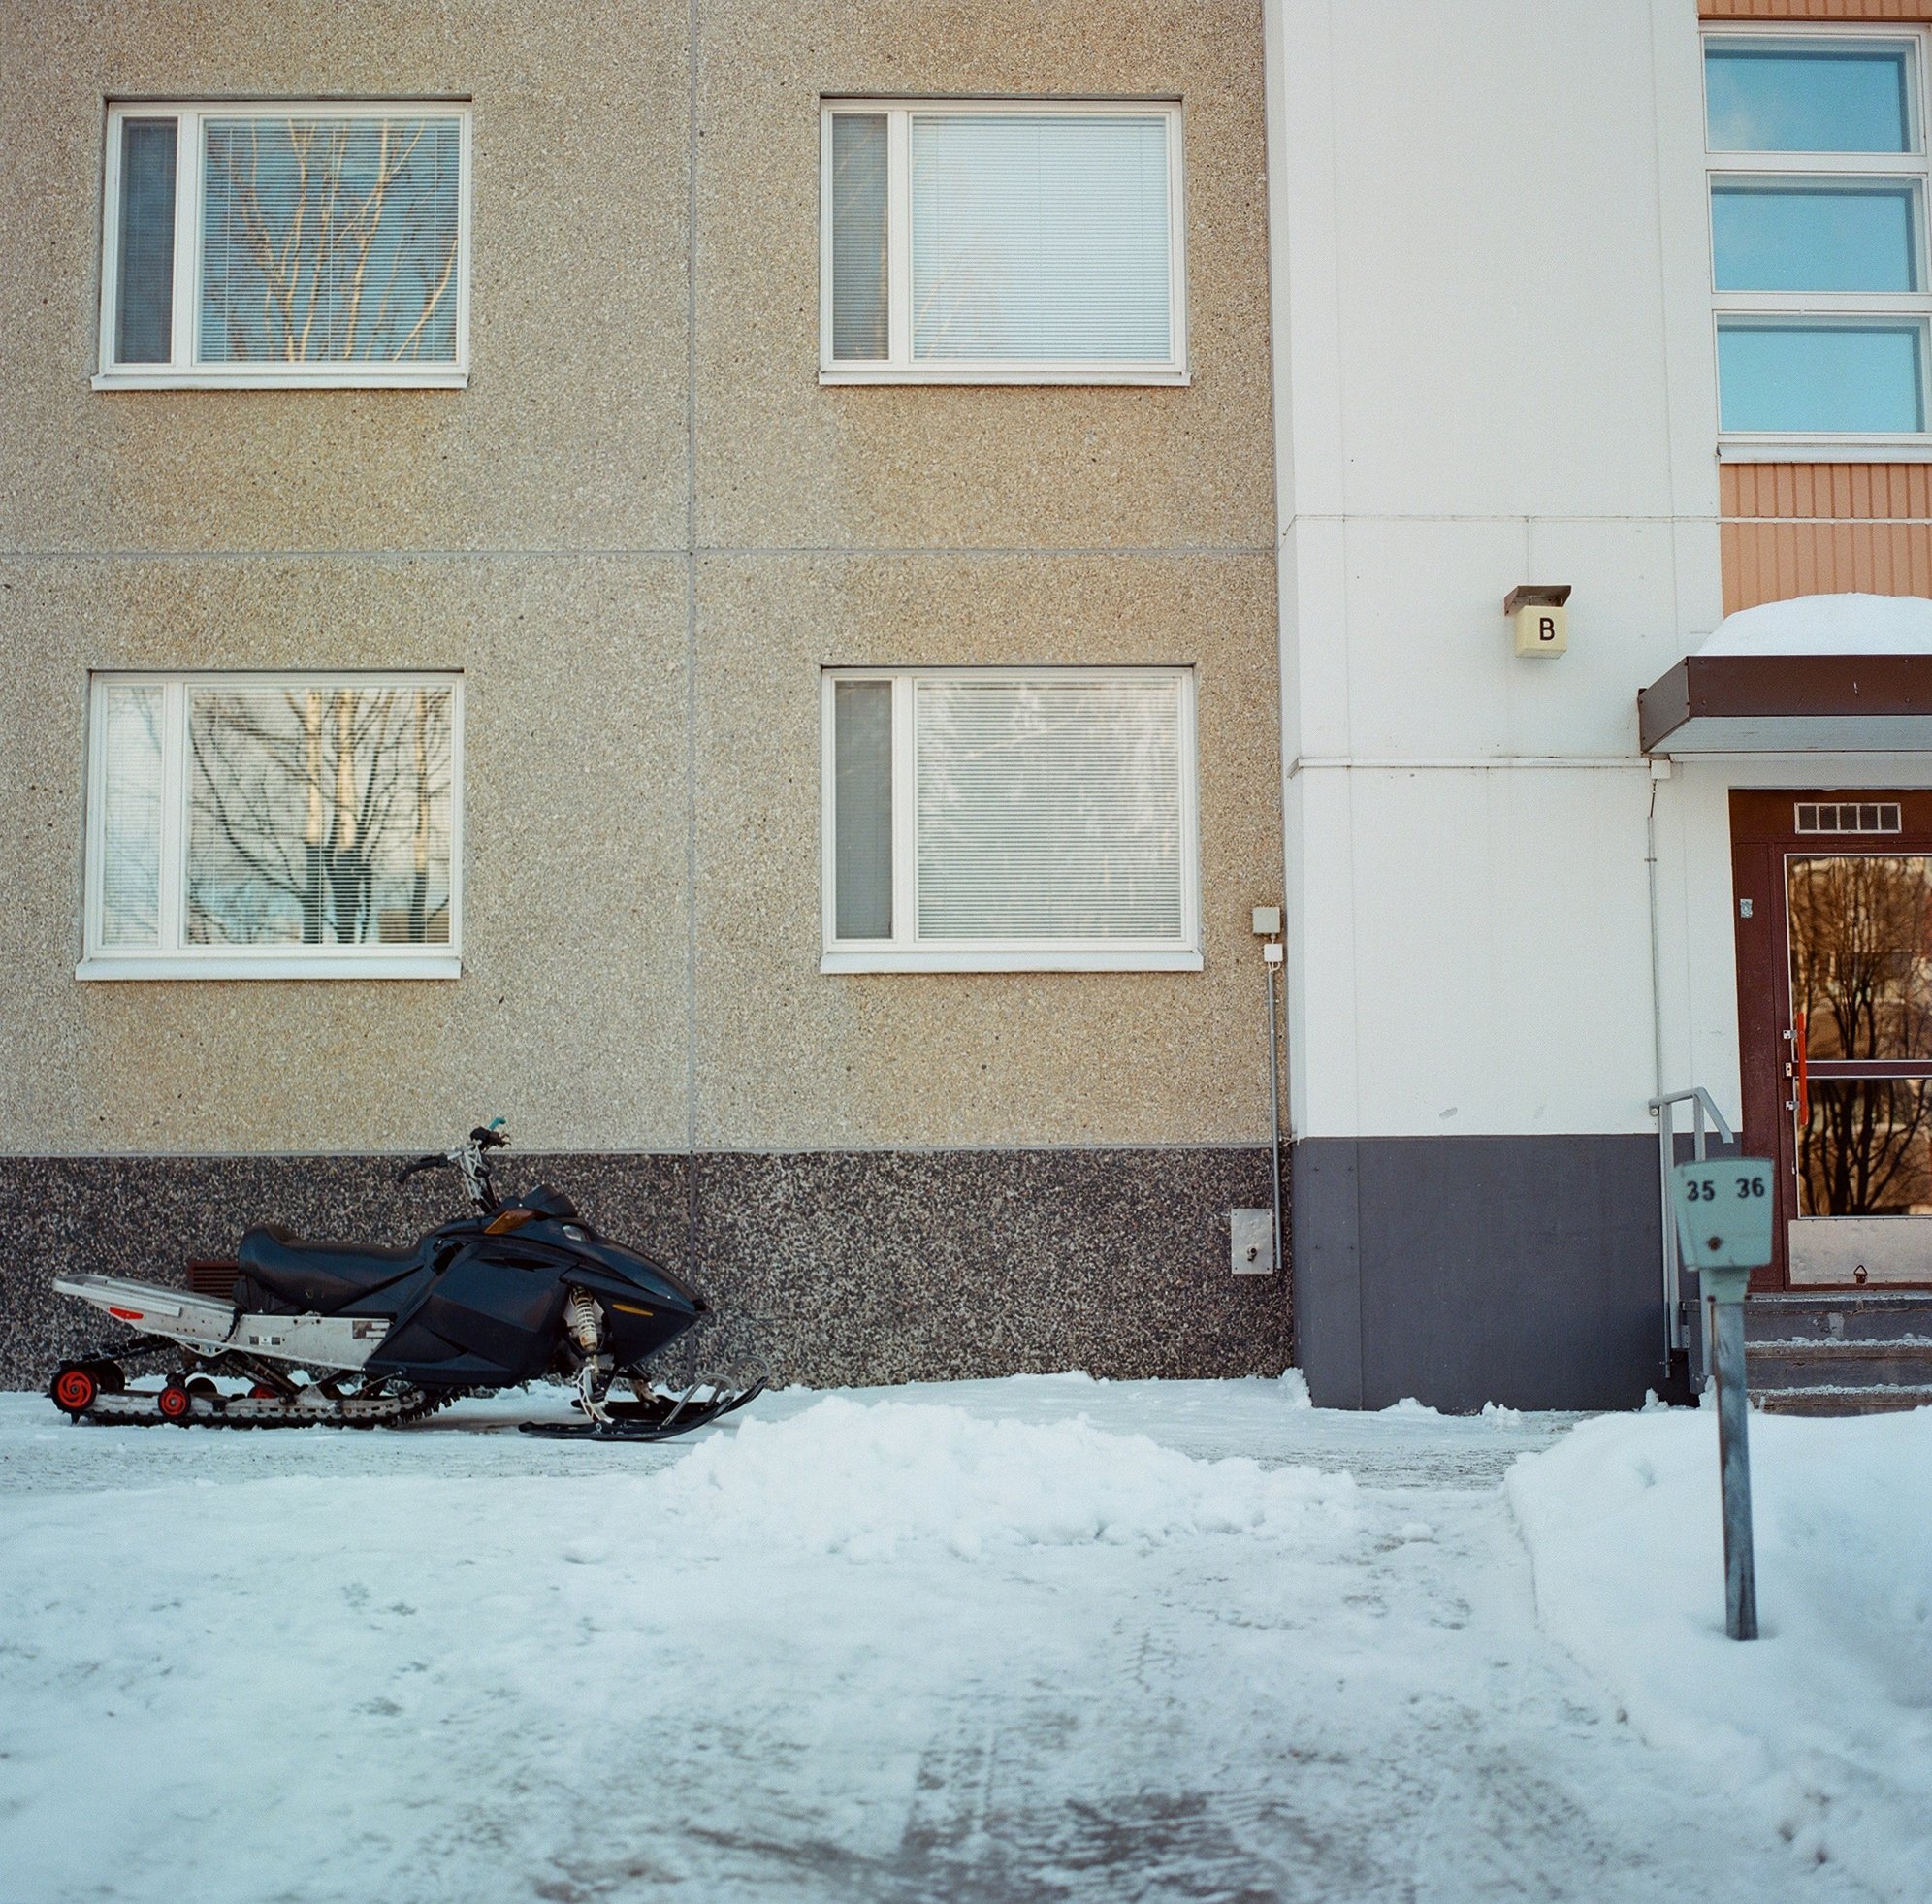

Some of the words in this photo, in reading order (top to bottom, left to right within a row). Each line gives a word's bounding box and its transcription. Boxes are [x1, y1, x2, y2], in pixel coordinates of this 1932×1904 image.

[1539, 617, 1555, 641] B
[1686, 1179, 1716, 1202] 35
[1735, 1177, 1765, 1199] 36
